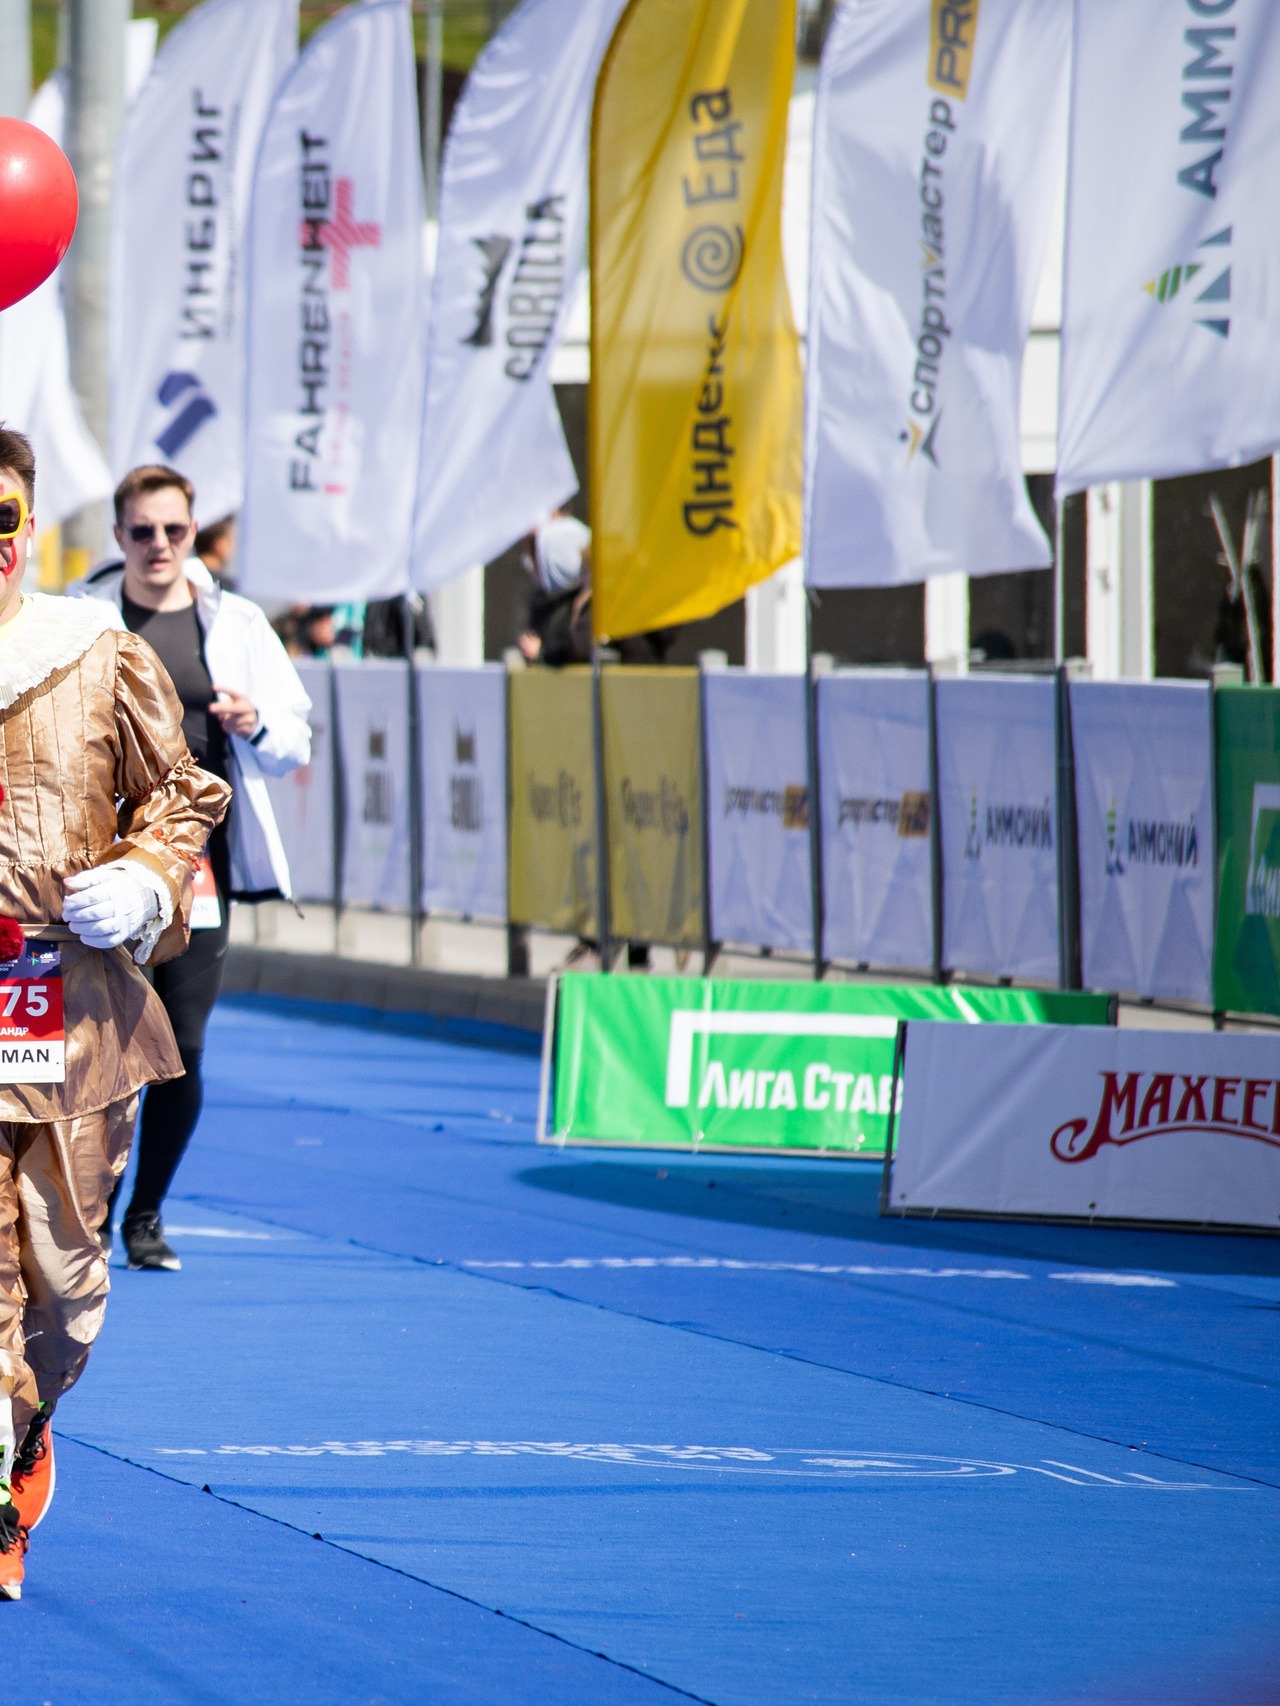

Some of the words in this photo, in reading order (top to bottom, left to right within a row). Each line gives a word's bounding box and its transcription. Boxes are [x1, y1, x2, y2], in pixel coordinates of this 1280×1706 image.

[683, 87, 745, 207] Еда
[1177, 0, 1238, 200] АММ
[289, 129, 330, 494] FAHRENHEIT
[504, 195, 564, 382] GORILLA
[1049, 1070, 1280, 1164] МАХЕЕ
